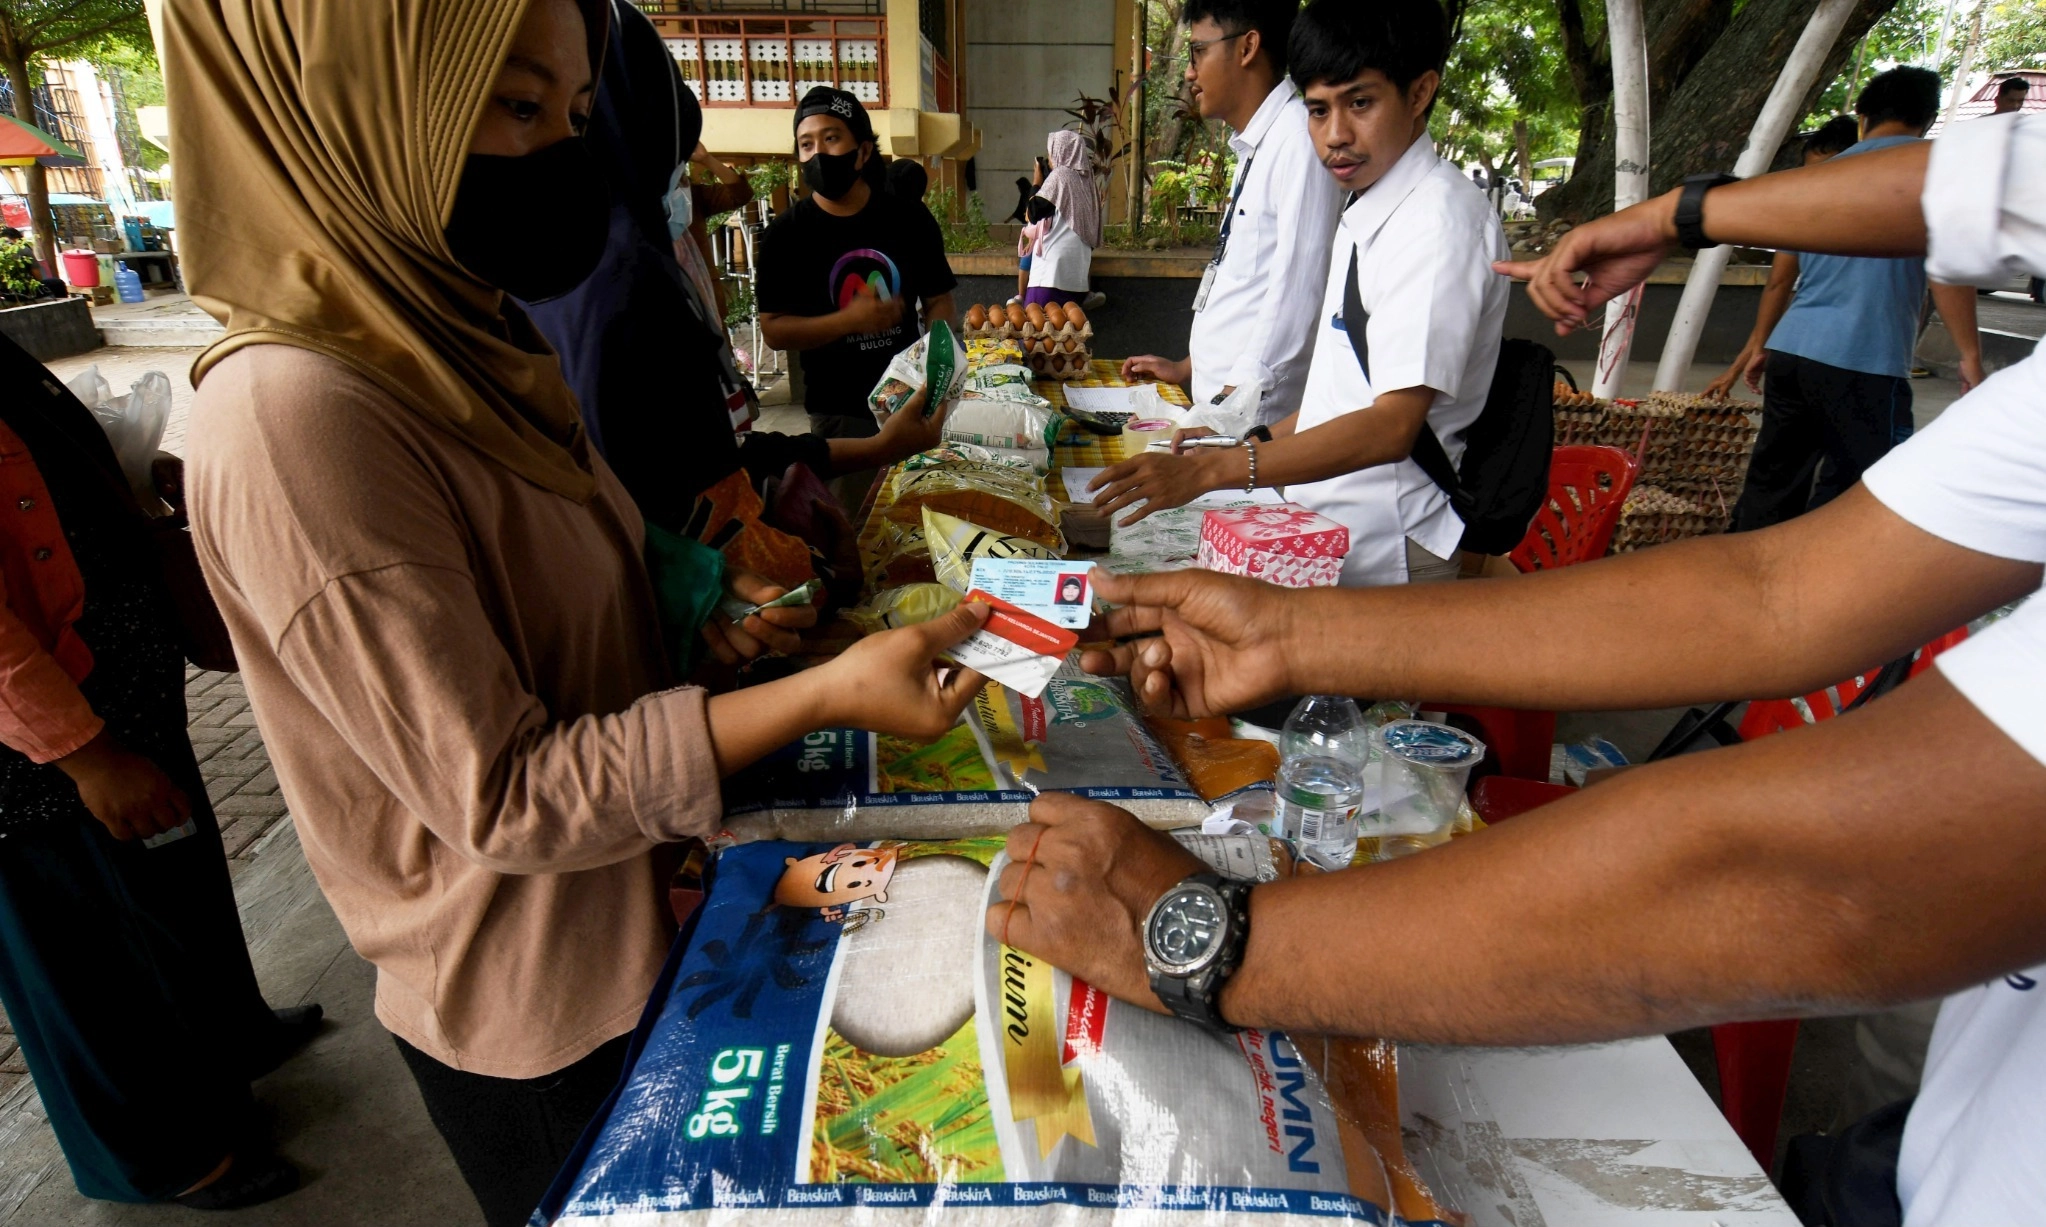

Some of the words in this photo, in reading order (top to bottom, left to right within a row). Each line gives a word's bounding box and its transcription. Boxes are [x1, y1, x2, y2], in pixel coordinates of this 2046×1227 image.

[831, 102, 852, 118] ZOO
[832, 95, 853, 110] VAPE
[847, 326, 902, 343] MARKETING
[860, 338, 893, 351] BULOG
[993, 610, 1008, 620] ARTU
[771, 1044, 790, 1081] Berat
[762, 1084, 783, 1135] Bersih
[1269, 1031, 1321, 1174] UMN
[1260, 1095, 1285, 1156] negeri
